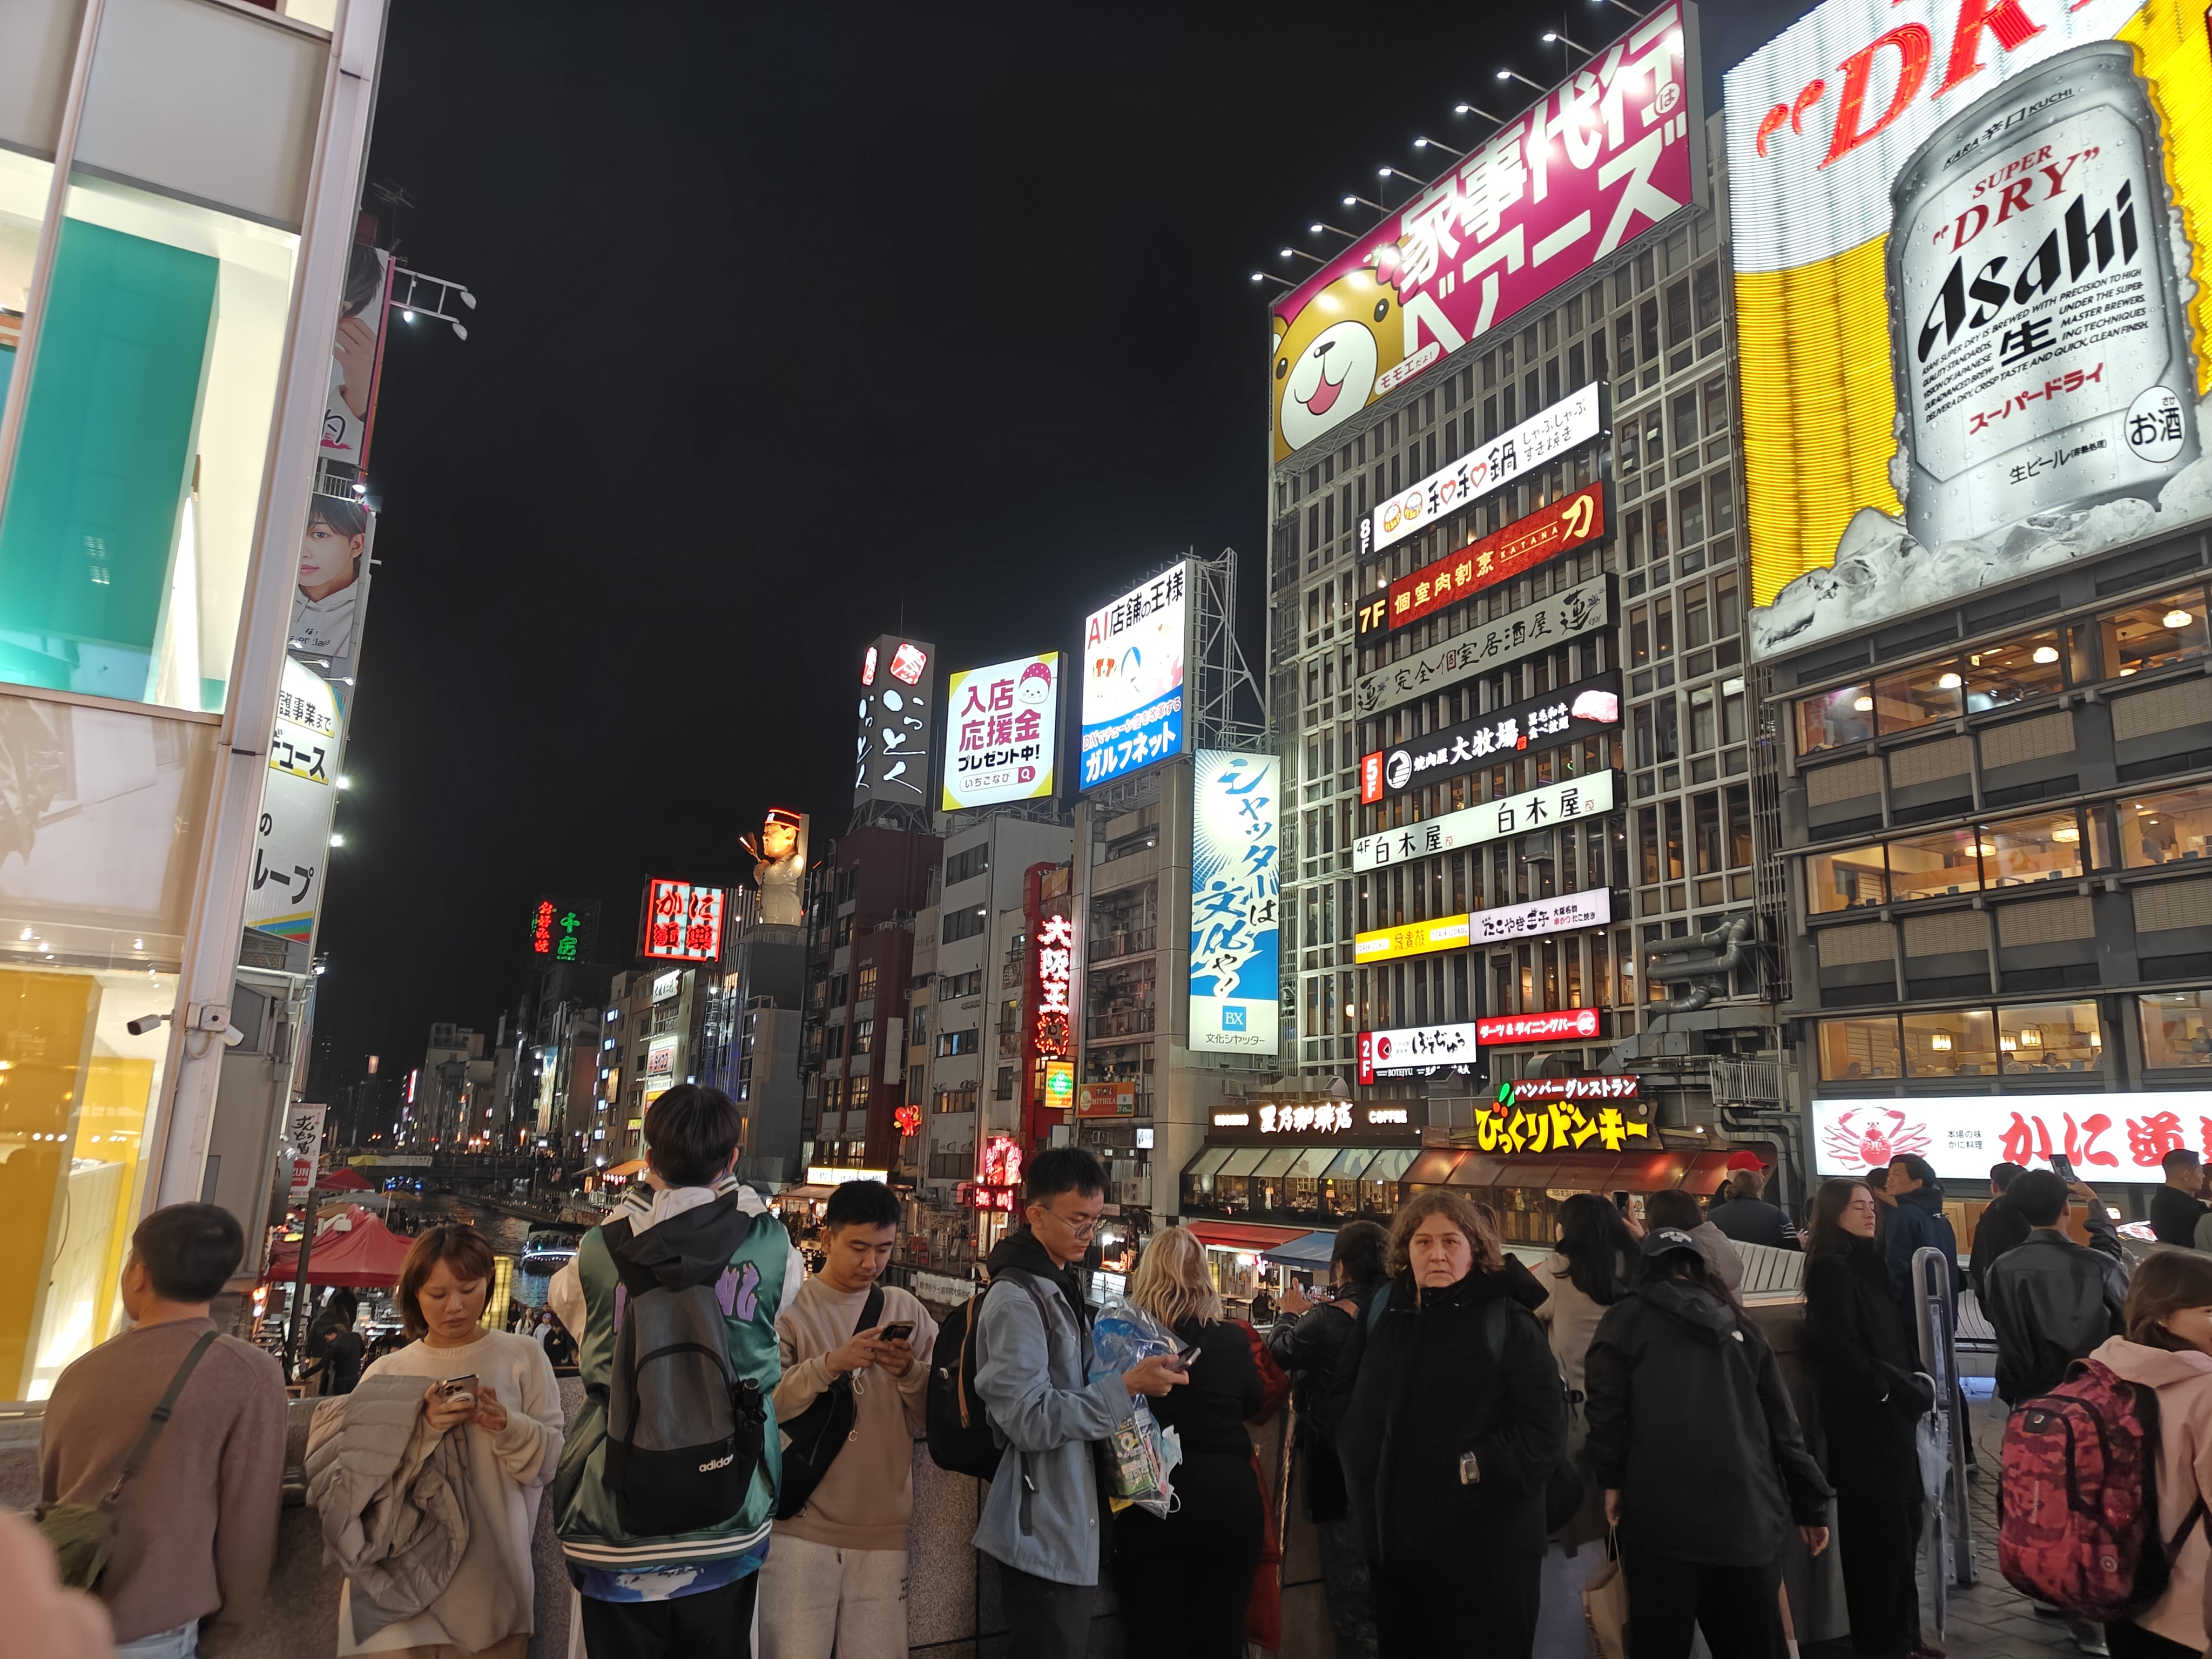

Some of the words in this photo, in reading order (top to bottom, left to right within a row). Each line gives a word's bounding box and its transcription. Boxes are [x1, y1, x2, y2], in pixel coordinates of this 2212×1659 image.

[1945, 137, 1980, 165] KARA
[1982, 107, 2026, 139] 辛口
[2028, 88, 2074, 112] KUCHI
[1973, 145, 2053, 200] SUPER
[1404, 112, 1687, 356] ベアーズ
[1918, 179, 2139, 363] Asahi
[1940, 343, 1963, 363] SUPER
[1964, 333, 1981, 348] DRY
[1982, 328, 1990, 339] IS
[1992, 308, 2029, 333] BREWED
[2032, 296, 2057, 314] WITH
[2059, 278, 2108, 302] PRECISION
[2110, 274, 2121, 284] TO
[2122, 268, 2142, 280] HIGH
[2059, 295, 2094, 315] UNDER
[2096, 288, 2115, 301] THE
[2060, 306, 2102, 328] MASTER
[1999, 316, 2056, 367] 生
[2062, 326, 2082, 341] ING
[2083, 307, 2147, 333] TECHNIQUES
[2000, 362, 2029, 382] TASTE
[2029, 351, 2053, 368] AND
[2089, 327, 2121, 345] CLEAN
[1968, 362, 2103, 436] スーパードライ
[1522, 397, 1587, 445] しゃぶしゃぶ
[2129, 406, 2183, 446] お酒
[1525, 427, 1572, 462] すき焼き
[1562, 495, 1595, 543] 刀
[1500, 526, 1559, 559] KATANA
[1394, 550, 1495, 615] 個室肉割烹
[1359, 599, 1386, 633] 7F
[1394, 610, 1552, 694] 完全個室居酒屋
[961, 678, 1015, 718] 入店
[959, 708, 1041, 753] 応援金
[1085, 720, 1176, 783] ガルフネット
[1449, 717, 1519, 766] 大牧場
[260, 813, 272, 837] の
[1498, 787, 1582, 834] 白木屋
[1357, 839, 1371, 854] 4F
[1375, 825, 1443, 865] 白木屋
[656, 889, 716, 921] かに
[1225, 1011, 1244, 1026] BX
[1514, 1078, 1637, 1099] ハンバーグレストラン
[1368, 1109, 1407, 1124] COFFEE
[1475, 1101, 1648, 1154] びっくりドンキー
[1947, 1130, 1982, 1140] 本場の味
[1948, 1141, 1984, 1150] かに料理
